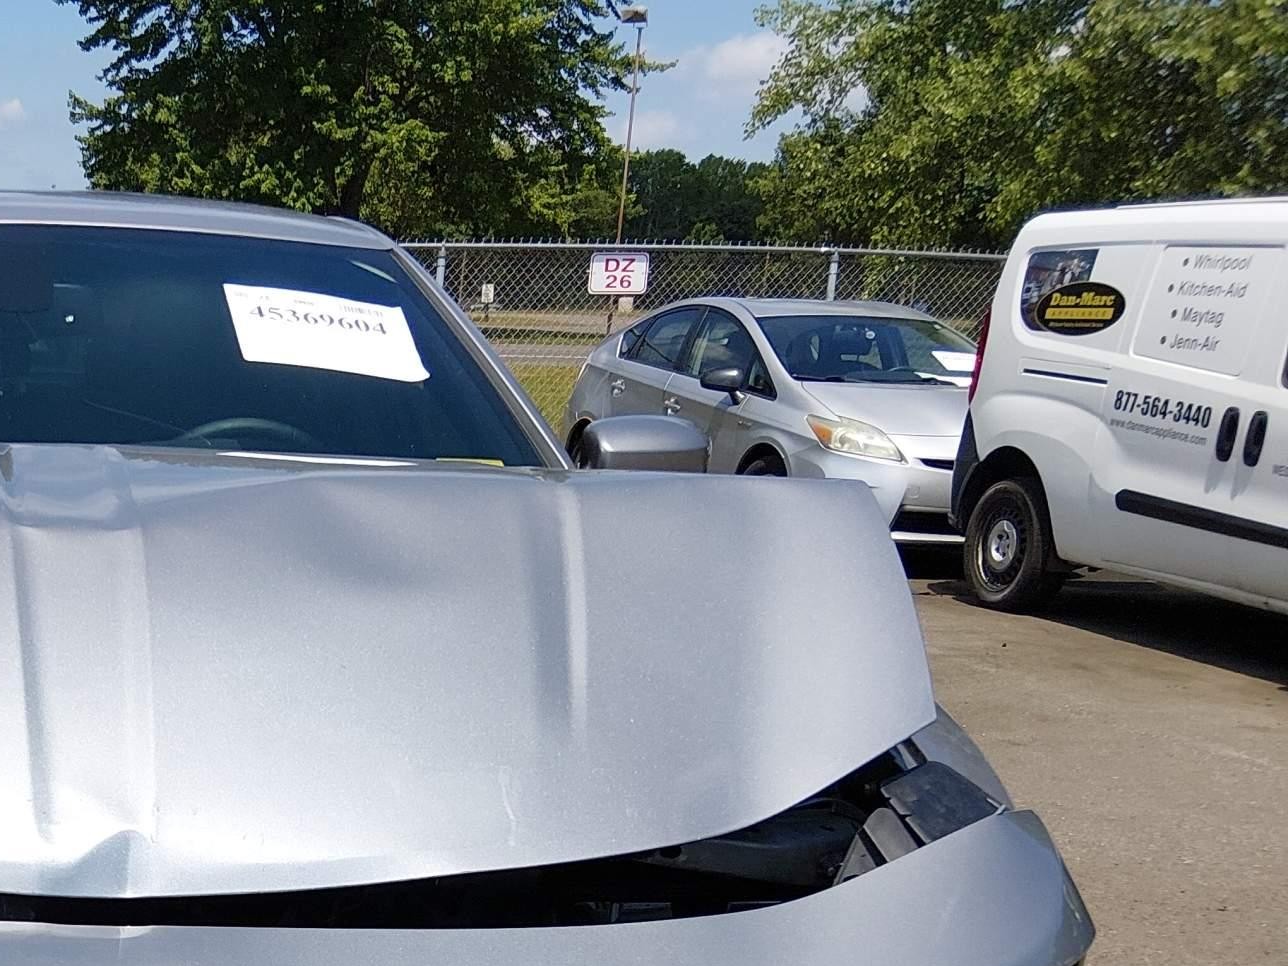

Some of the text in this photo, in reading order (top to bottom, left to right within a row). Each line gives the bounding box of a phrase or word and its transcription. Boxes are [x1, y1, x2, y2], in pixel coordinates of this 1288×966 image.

[604, 258, 636, 273] DZ
[1194, 254, 1253, 273] Whirlpool
[605, 275, 632, 288] 26
[1177, 280, 1248, 298] Kitchen-Aid
[249, 305, 387, 335] 45369604
[1181, 307, 1225, 328] Maytag
[1169, 334, 1221, 352] Jenn-Air
[1114, 390, 1212, 428] 877-564-3440
